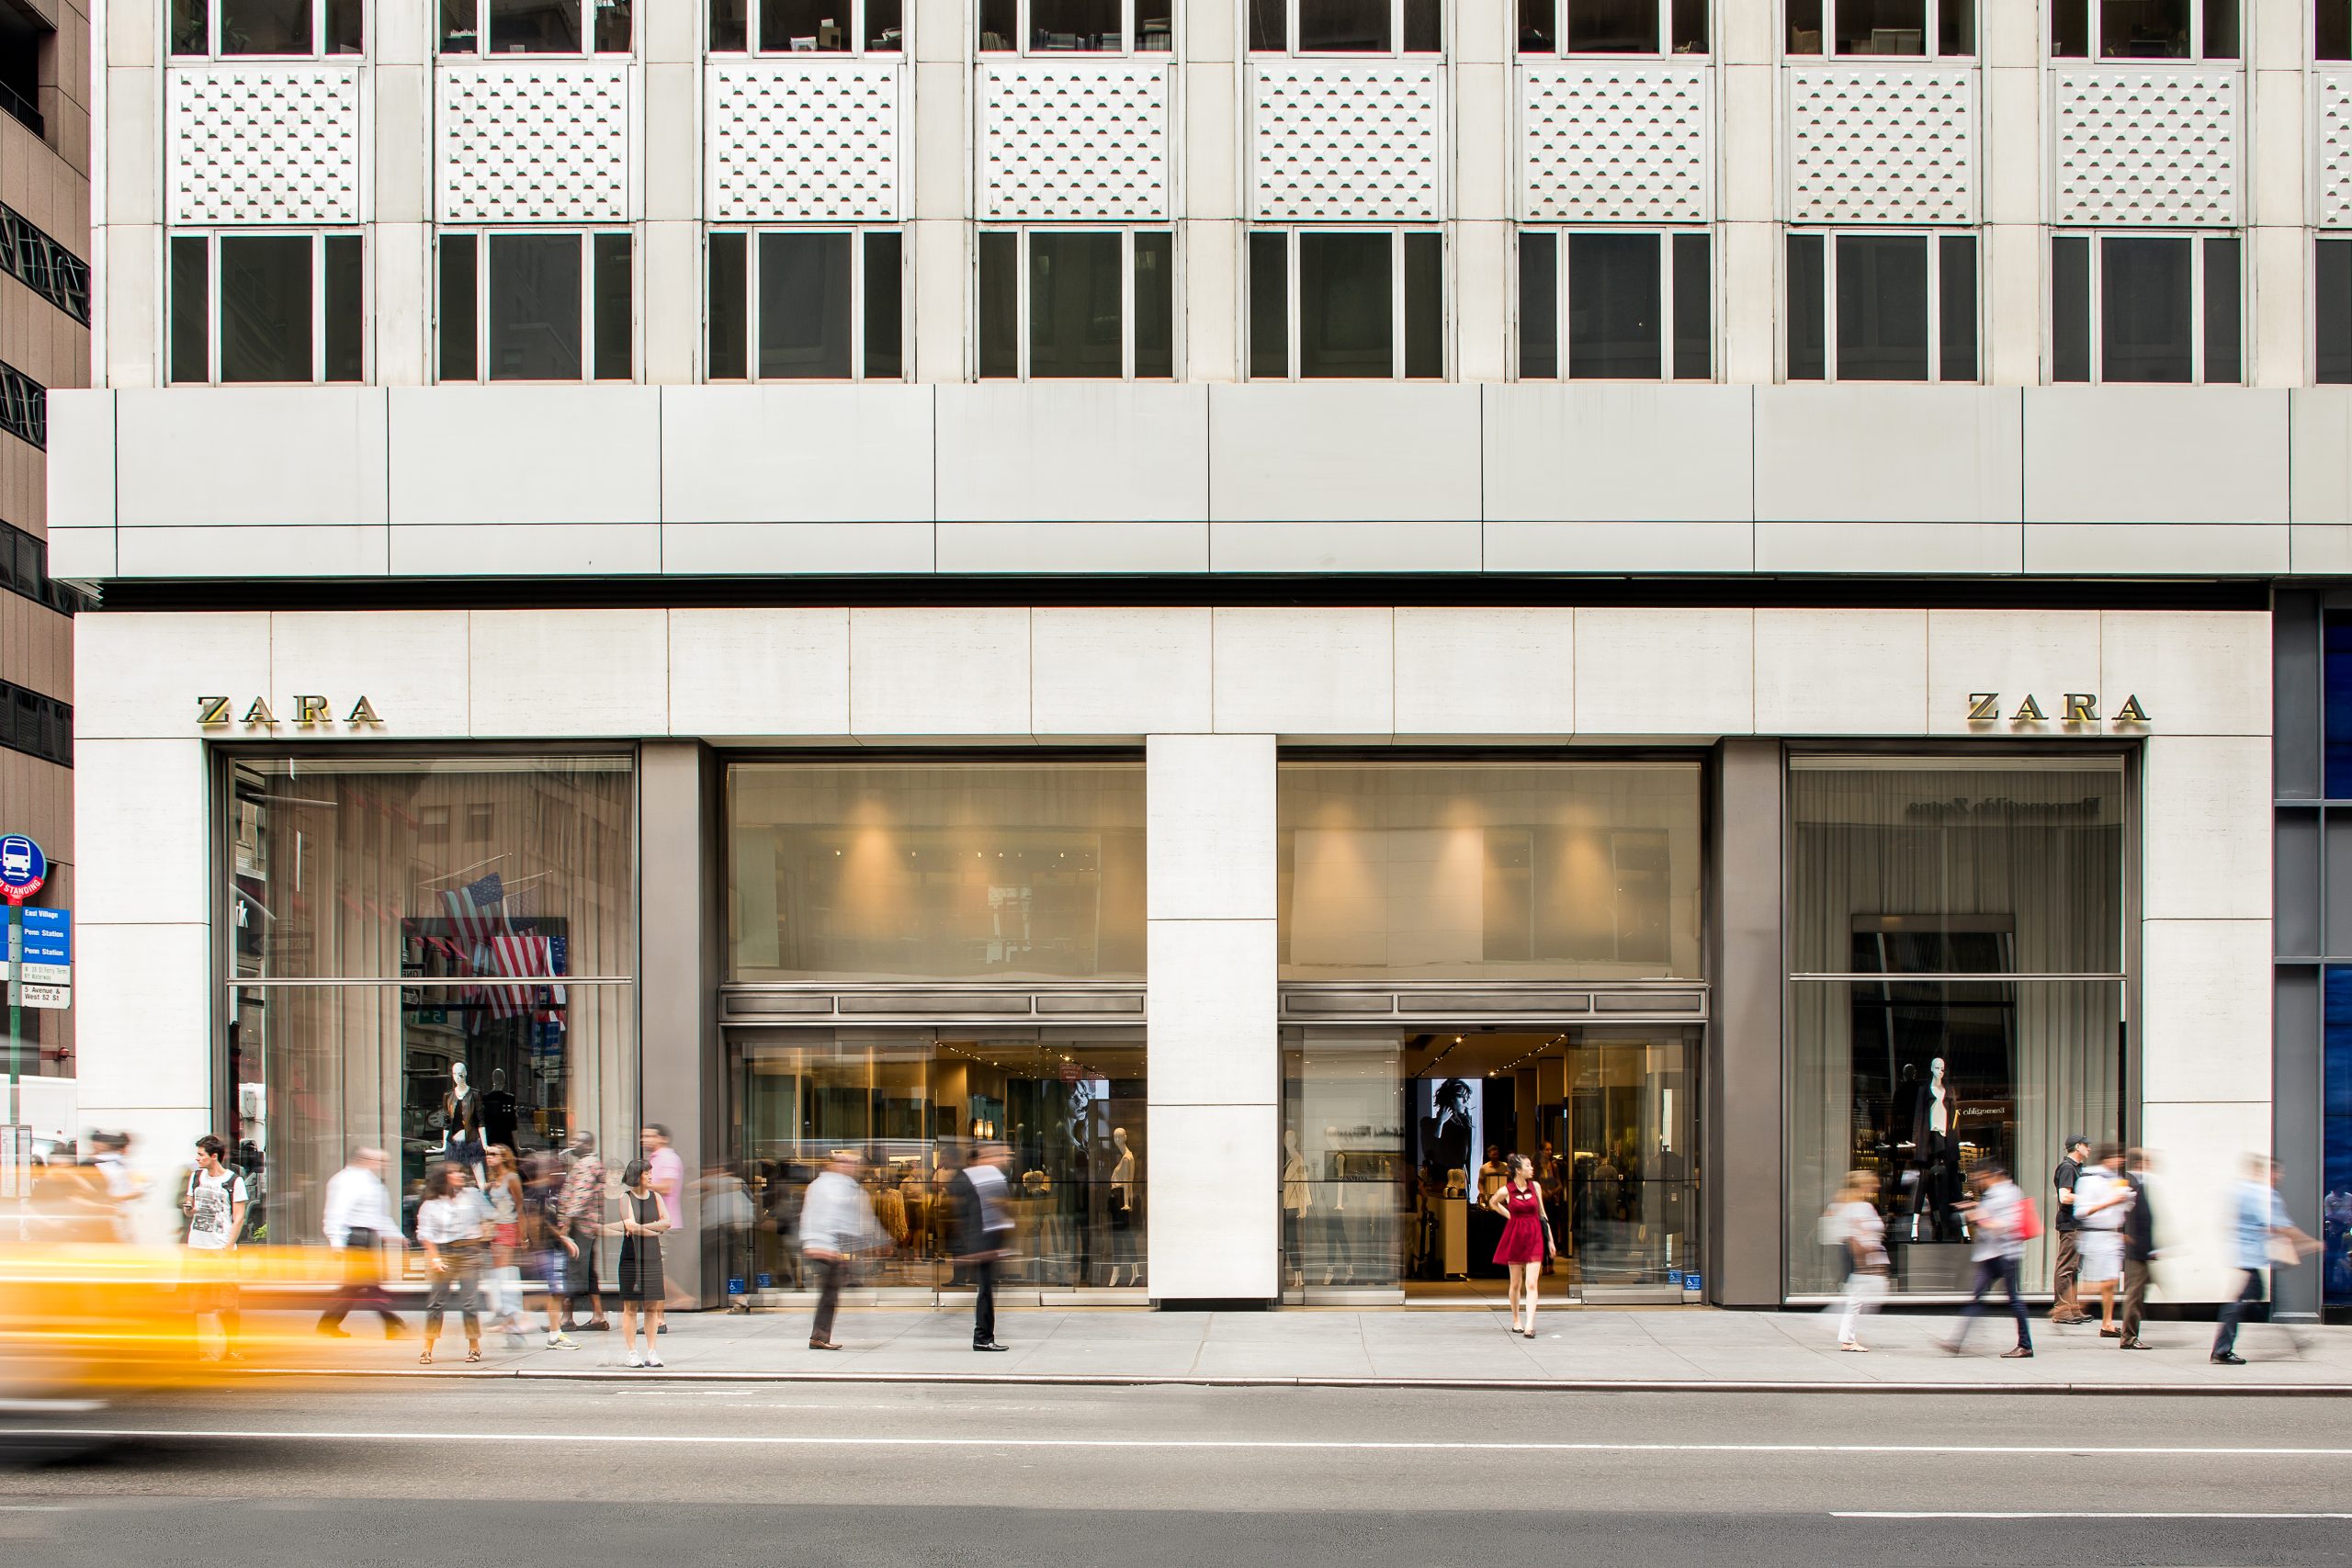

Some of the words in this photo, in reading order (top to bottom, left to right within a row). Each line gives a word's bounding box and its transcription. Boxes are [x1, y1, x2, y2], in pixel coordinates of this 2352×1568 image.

[197, 695, 384, 724] ZARA
[1967, 693, 2152, 721] ZARA
[4, 879, 41, 895] STANDING
[24, 908, 38, 917] East
[38, 909, 59, 919] Village
[24, 928, 40, 936] Penn
[41, 929, 64, 938] Station
[41, 948, 64, 956] Station
